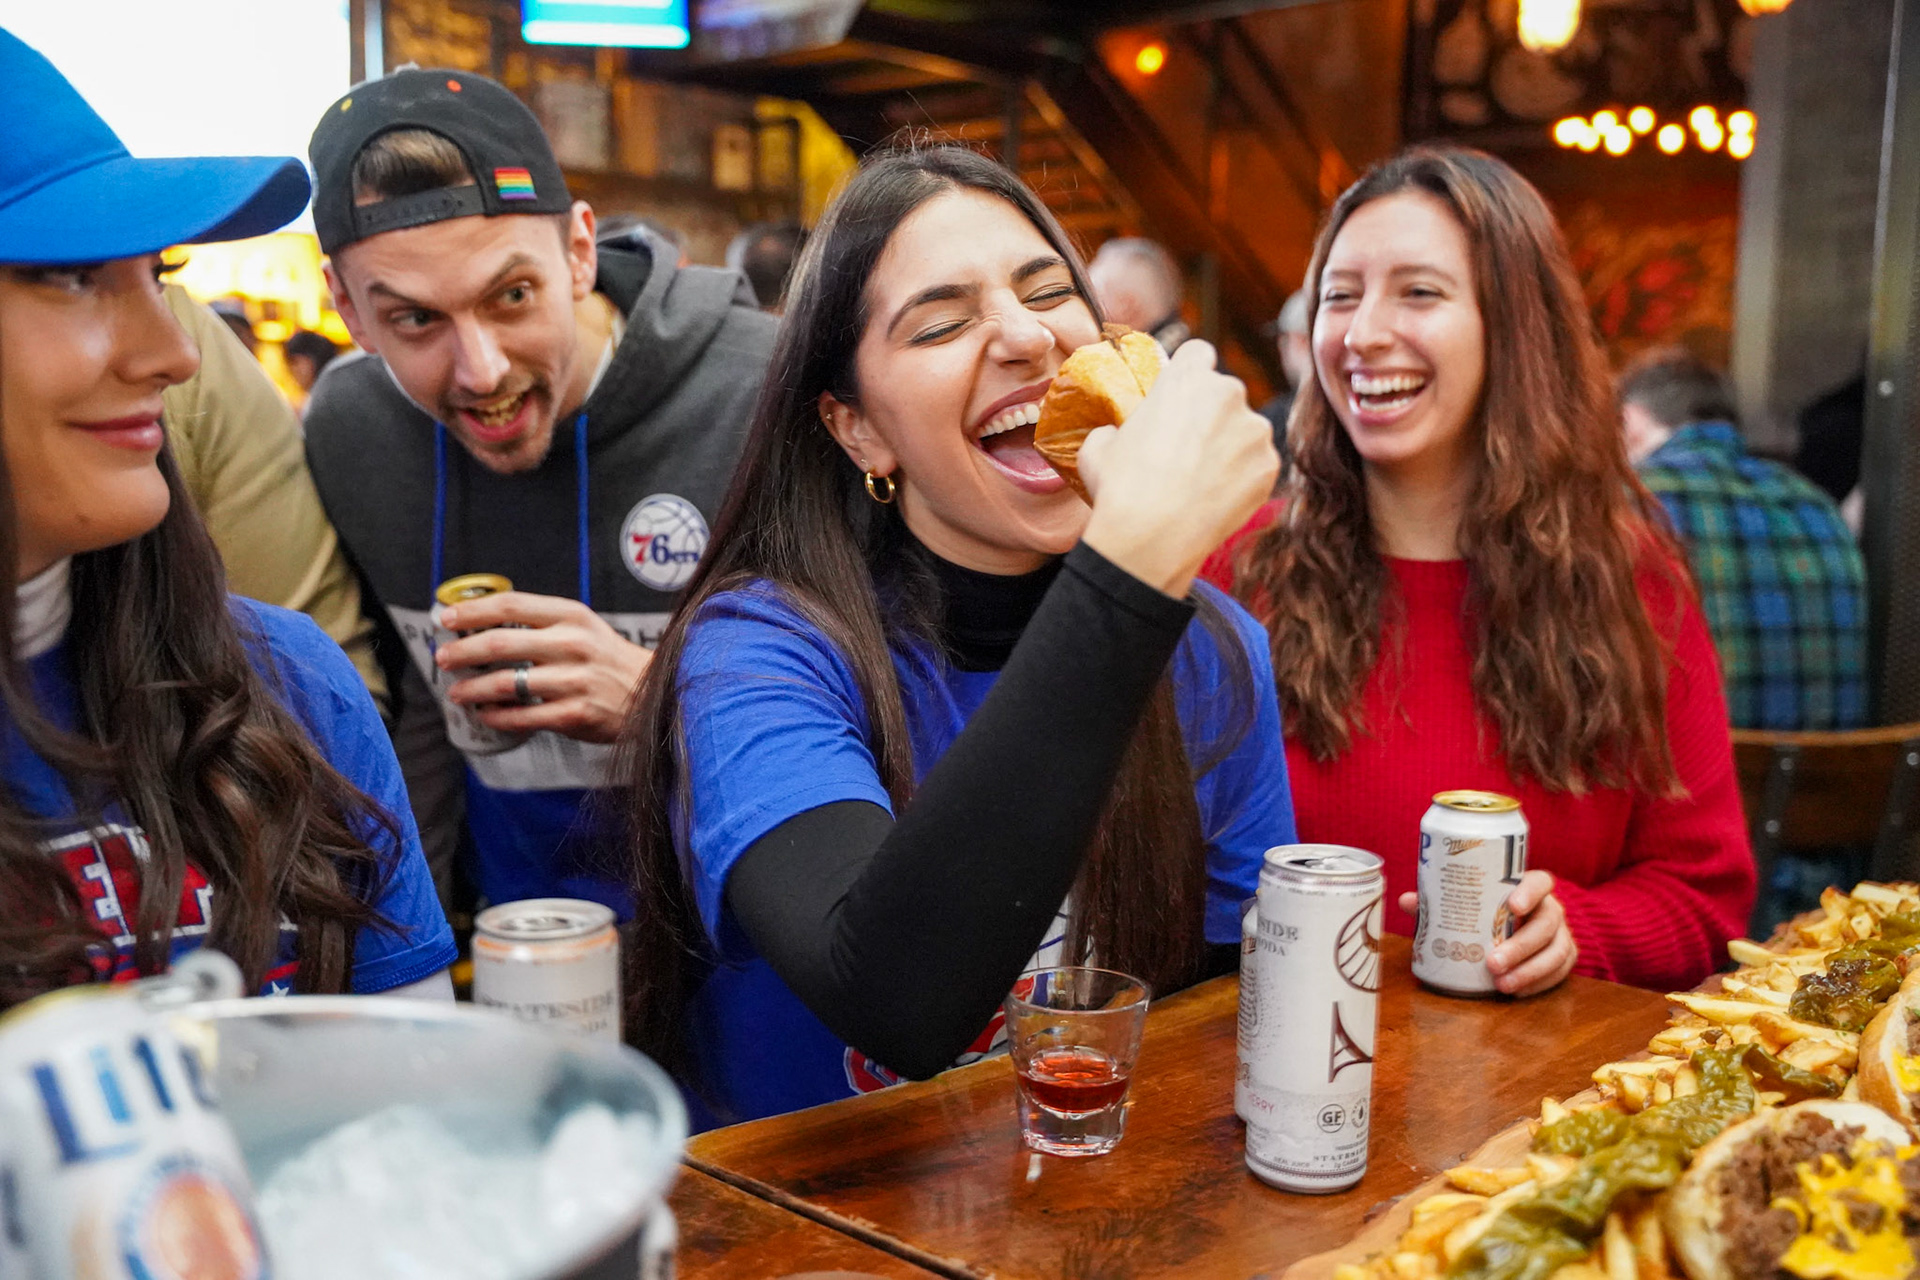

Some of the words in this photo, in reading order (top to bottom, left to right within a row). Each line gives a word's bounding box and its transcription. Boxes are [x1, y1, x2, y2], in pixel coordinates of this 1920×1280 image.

[631, 533, 699, 566] 76ers
[1442, 837, 1484, 856] Miller
[1322, 1111, 1342, 1124] GF
